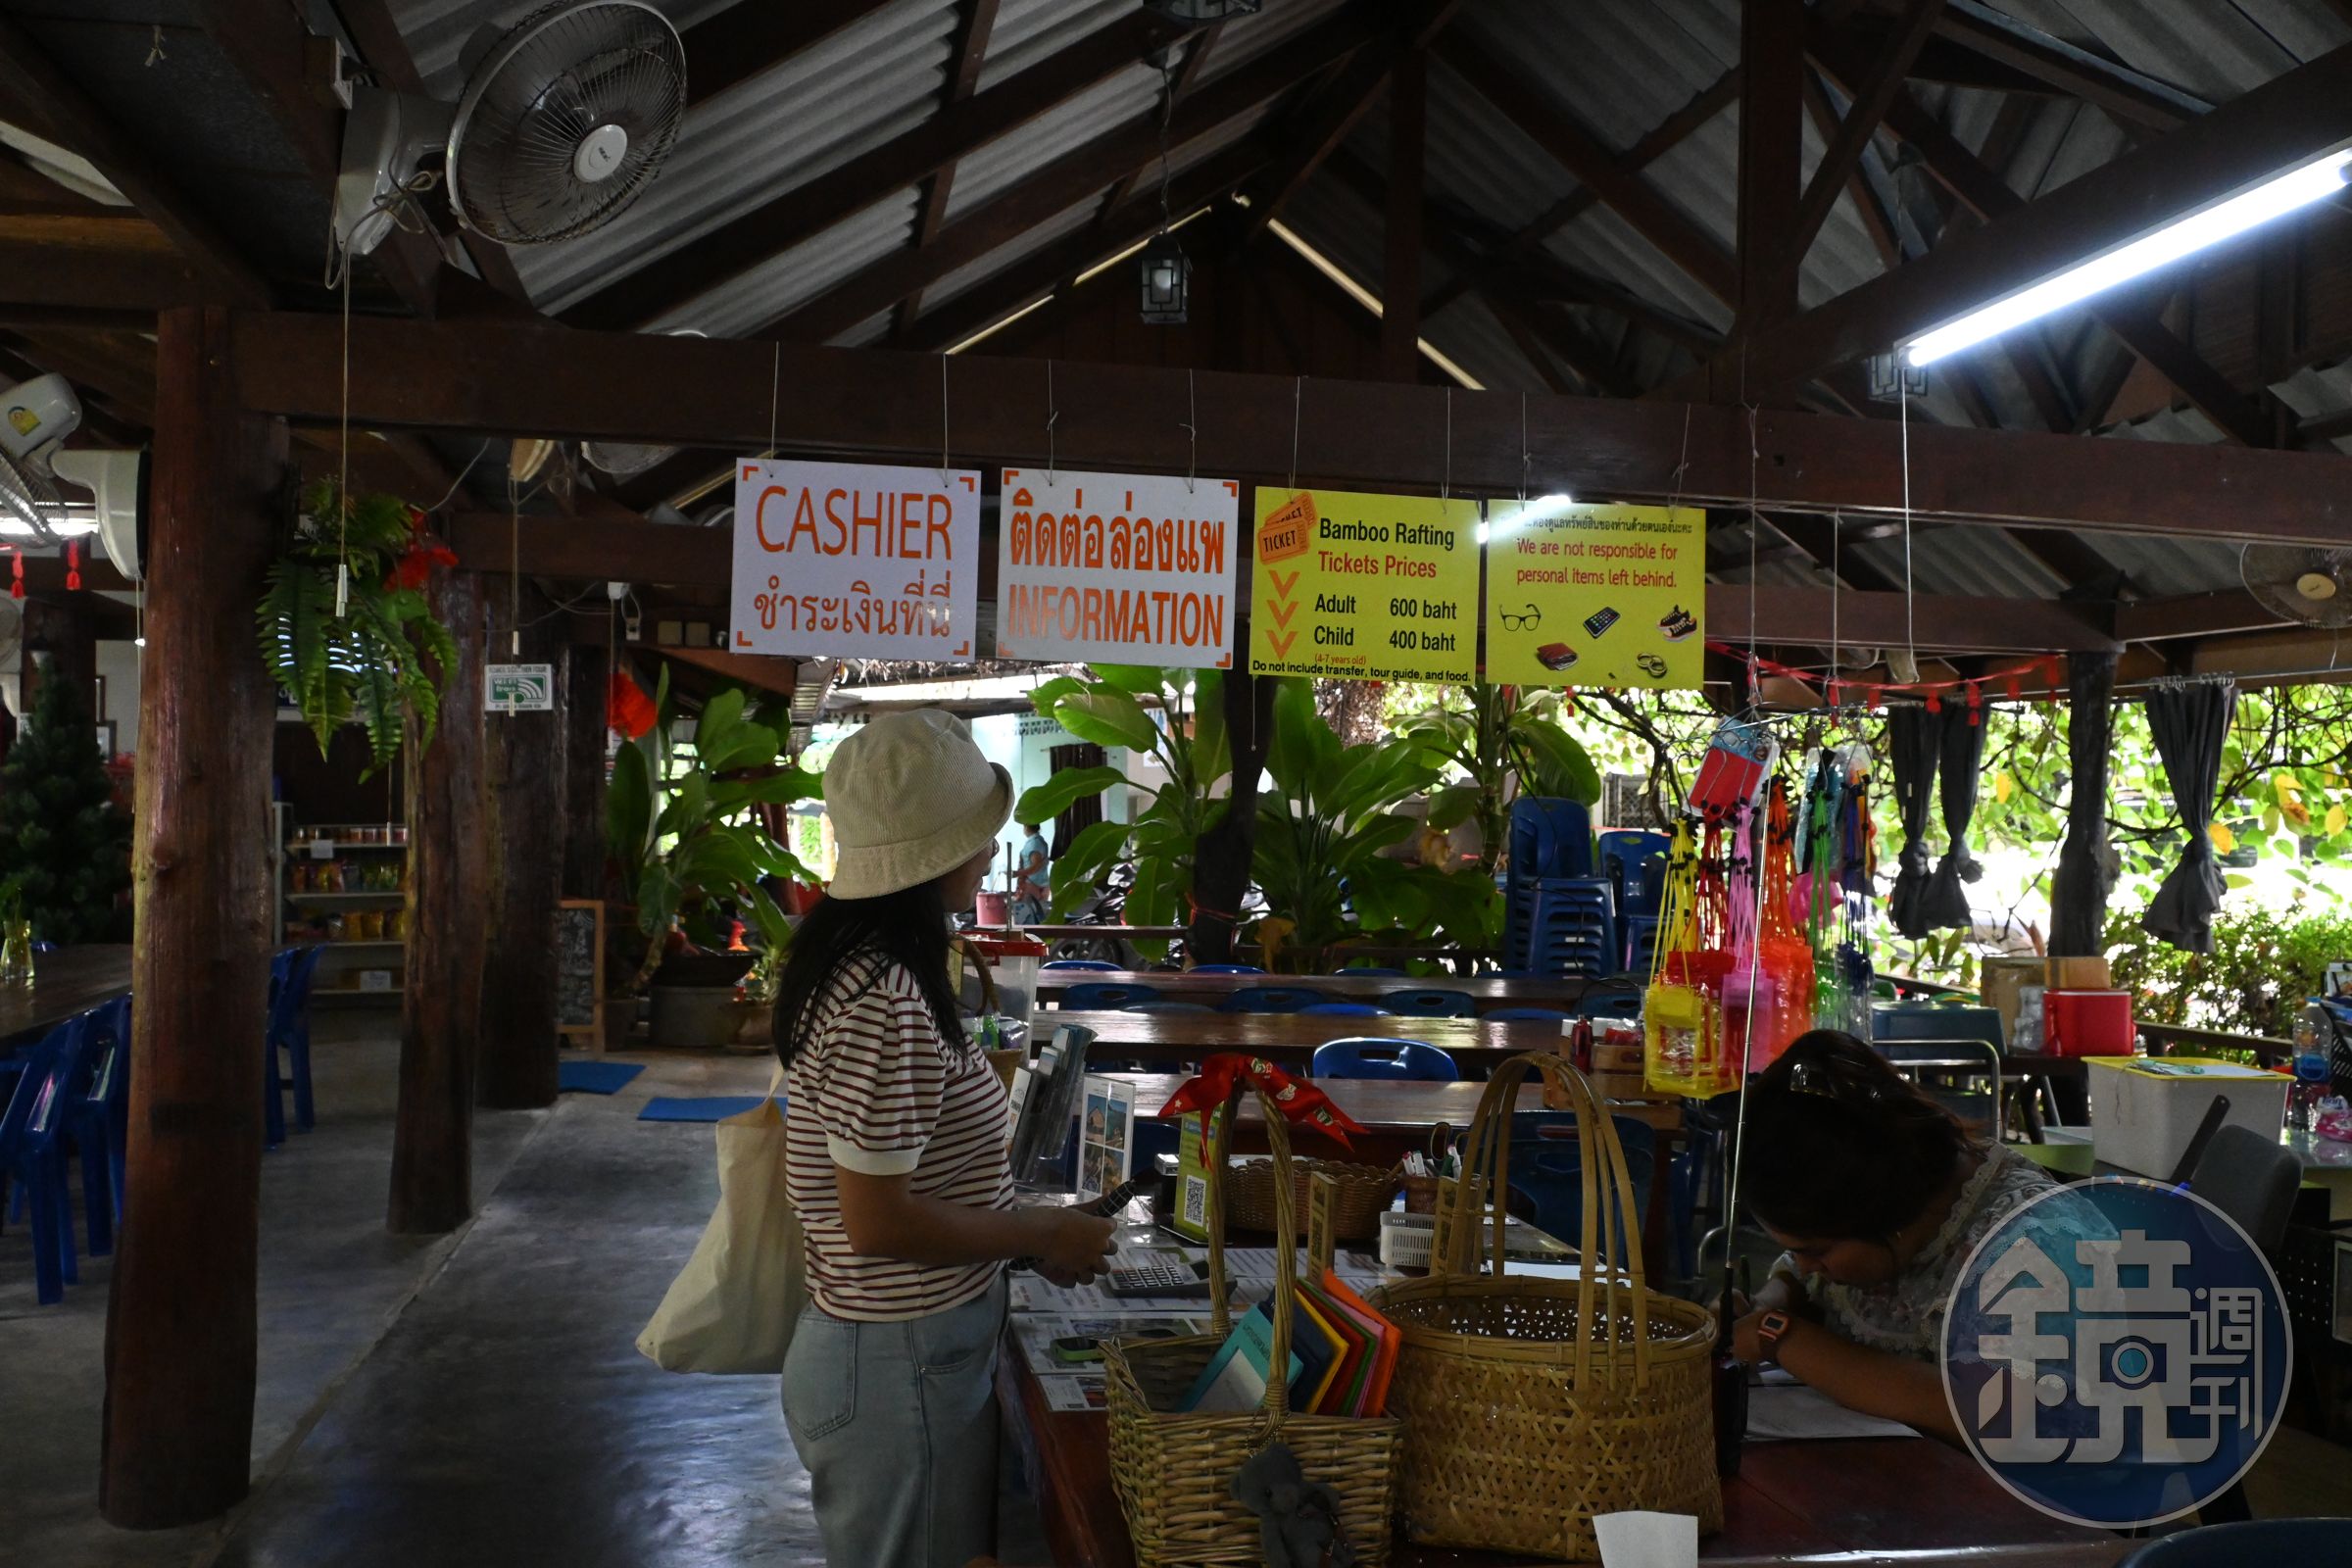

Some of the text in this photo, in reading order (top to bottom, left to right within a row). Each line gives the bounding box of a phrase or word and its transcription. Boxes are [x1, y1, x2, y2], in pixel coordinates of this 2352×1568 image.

[756, 485, 953, 561] CASHIER
[1009, 488, 1224, 574] ติดต่อล่องแพ
[1319, 517, 1455, 552] Bamboo Rafting
[1263, 530, 1297, 553] TICKET
[1517, 540, 1678, 562] We are not responsible for
[1317, 551, 1438, 578] Tickets Prices
[1517, 567, 1677, 588] personal items left behind.
[754, 569, 952, 638] ชำระเงินที่นี่
[1008, 584, 1223, 648] INFORMATION
[1315, 593, 1457, 619] Adult 600 baht
[1314, 625, 1456, 652] Child 400 baht
[1252, 661, 1471, 682] Do not include transfer, tour guide, and food.
[1314, 654, 1367, 665] (4-7 years old)
